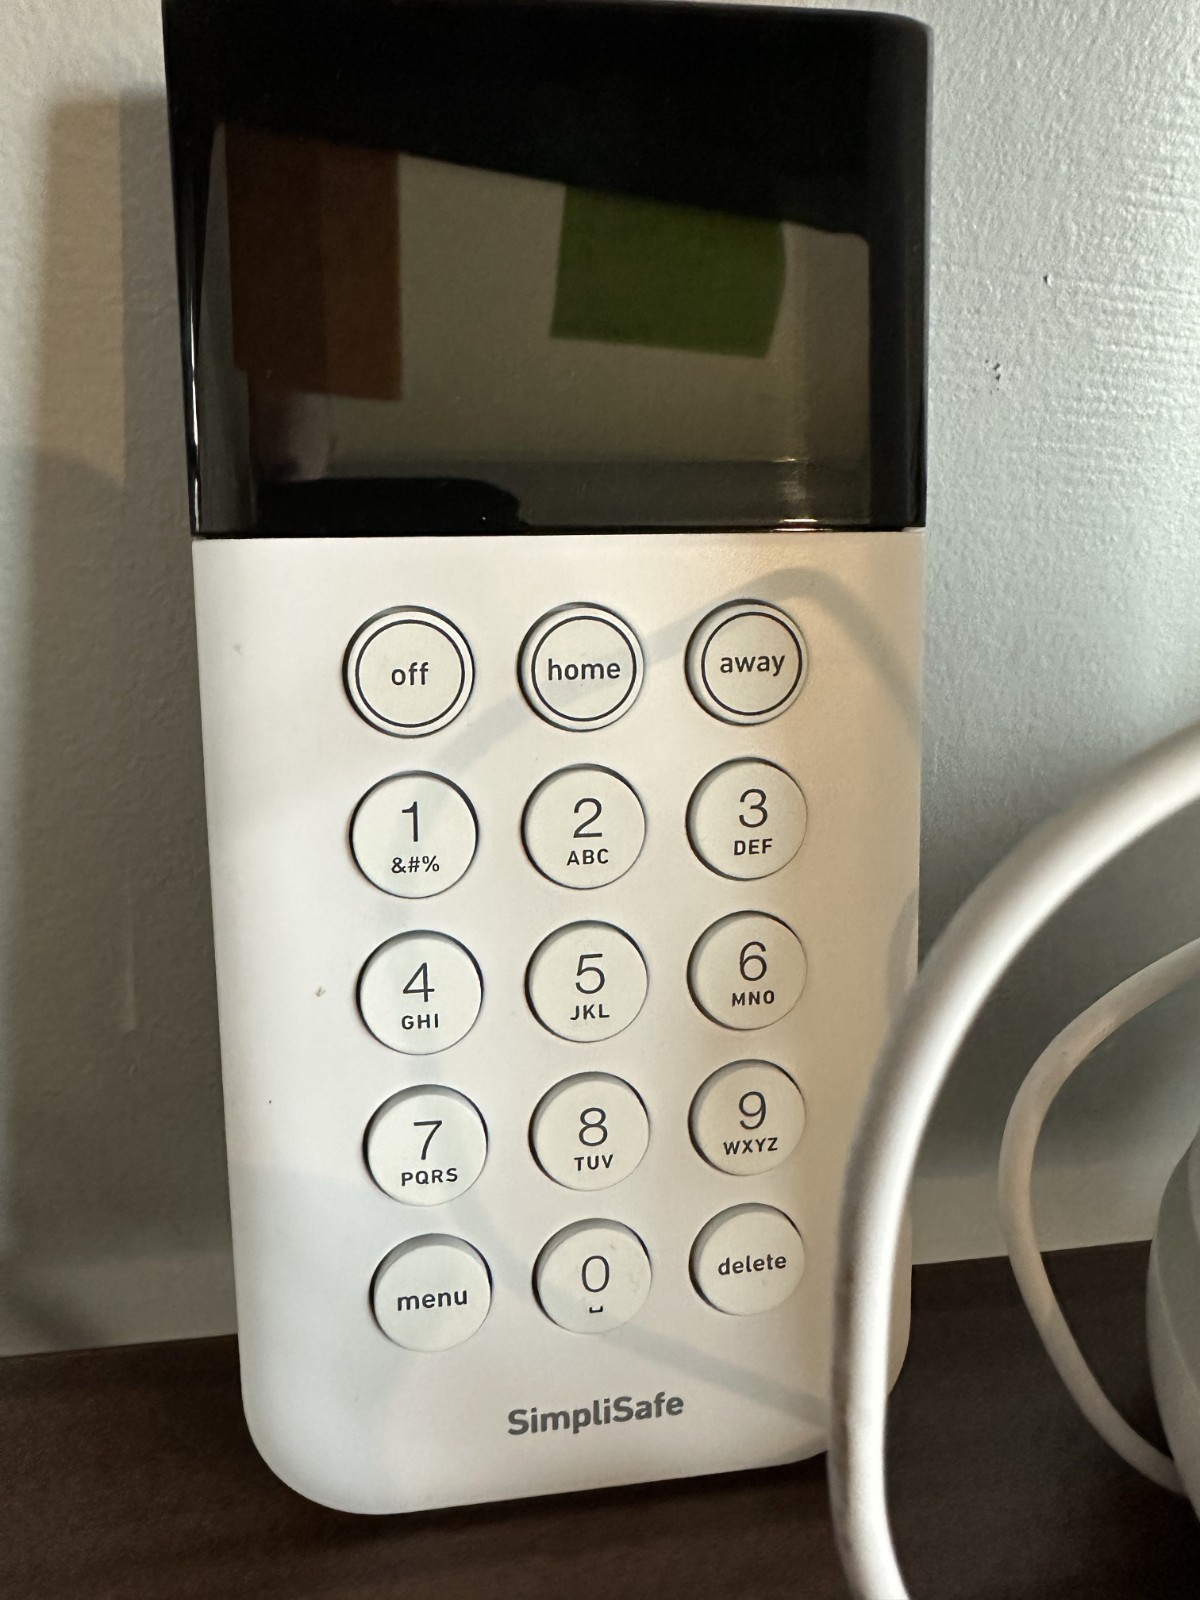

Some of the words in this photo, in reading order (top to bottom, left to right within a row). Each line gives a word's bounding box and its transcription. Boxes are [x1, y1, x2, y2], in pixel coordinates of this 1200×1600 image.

[391, 661, 429, 686] off
[548, 658, 621, 681] home
[719, 654, 786, 677] away
[573, 797, 603, 839] 2
[738, 788, 768, 829] 3
[401, 801, 419, 843] 1
[566, 848, 609, 866] ABC
[733, 837, 773, 856] DEF
[391, 855, 440, 874] &#%
[739, 941, 768, 982] 6
[402, 962, 435, 1004] 4
[575, 953, 606, 995] 5
[731, 989, 775, 1007] MNO
[401, 1013, 439, 1031] GHI
[569, 1003, 610, 1021] JKL
[738, 1091, 767, 1131] 9
[578, 1107, 608, 1147] 8
[413, 1119, 443, 1161] 7
[722, 1136, 778, 1156] WXYZ
[573, 1153, 614, 1172] TUV
[401, 1167, 458, 1187] PQRS
[581, 1255, 610, 1294] 0
[717, 1253, 787, 1276] delete
[397, 1290, 468, 1312] menu
[507, 1391, 684, 1436] SimpliSafe
